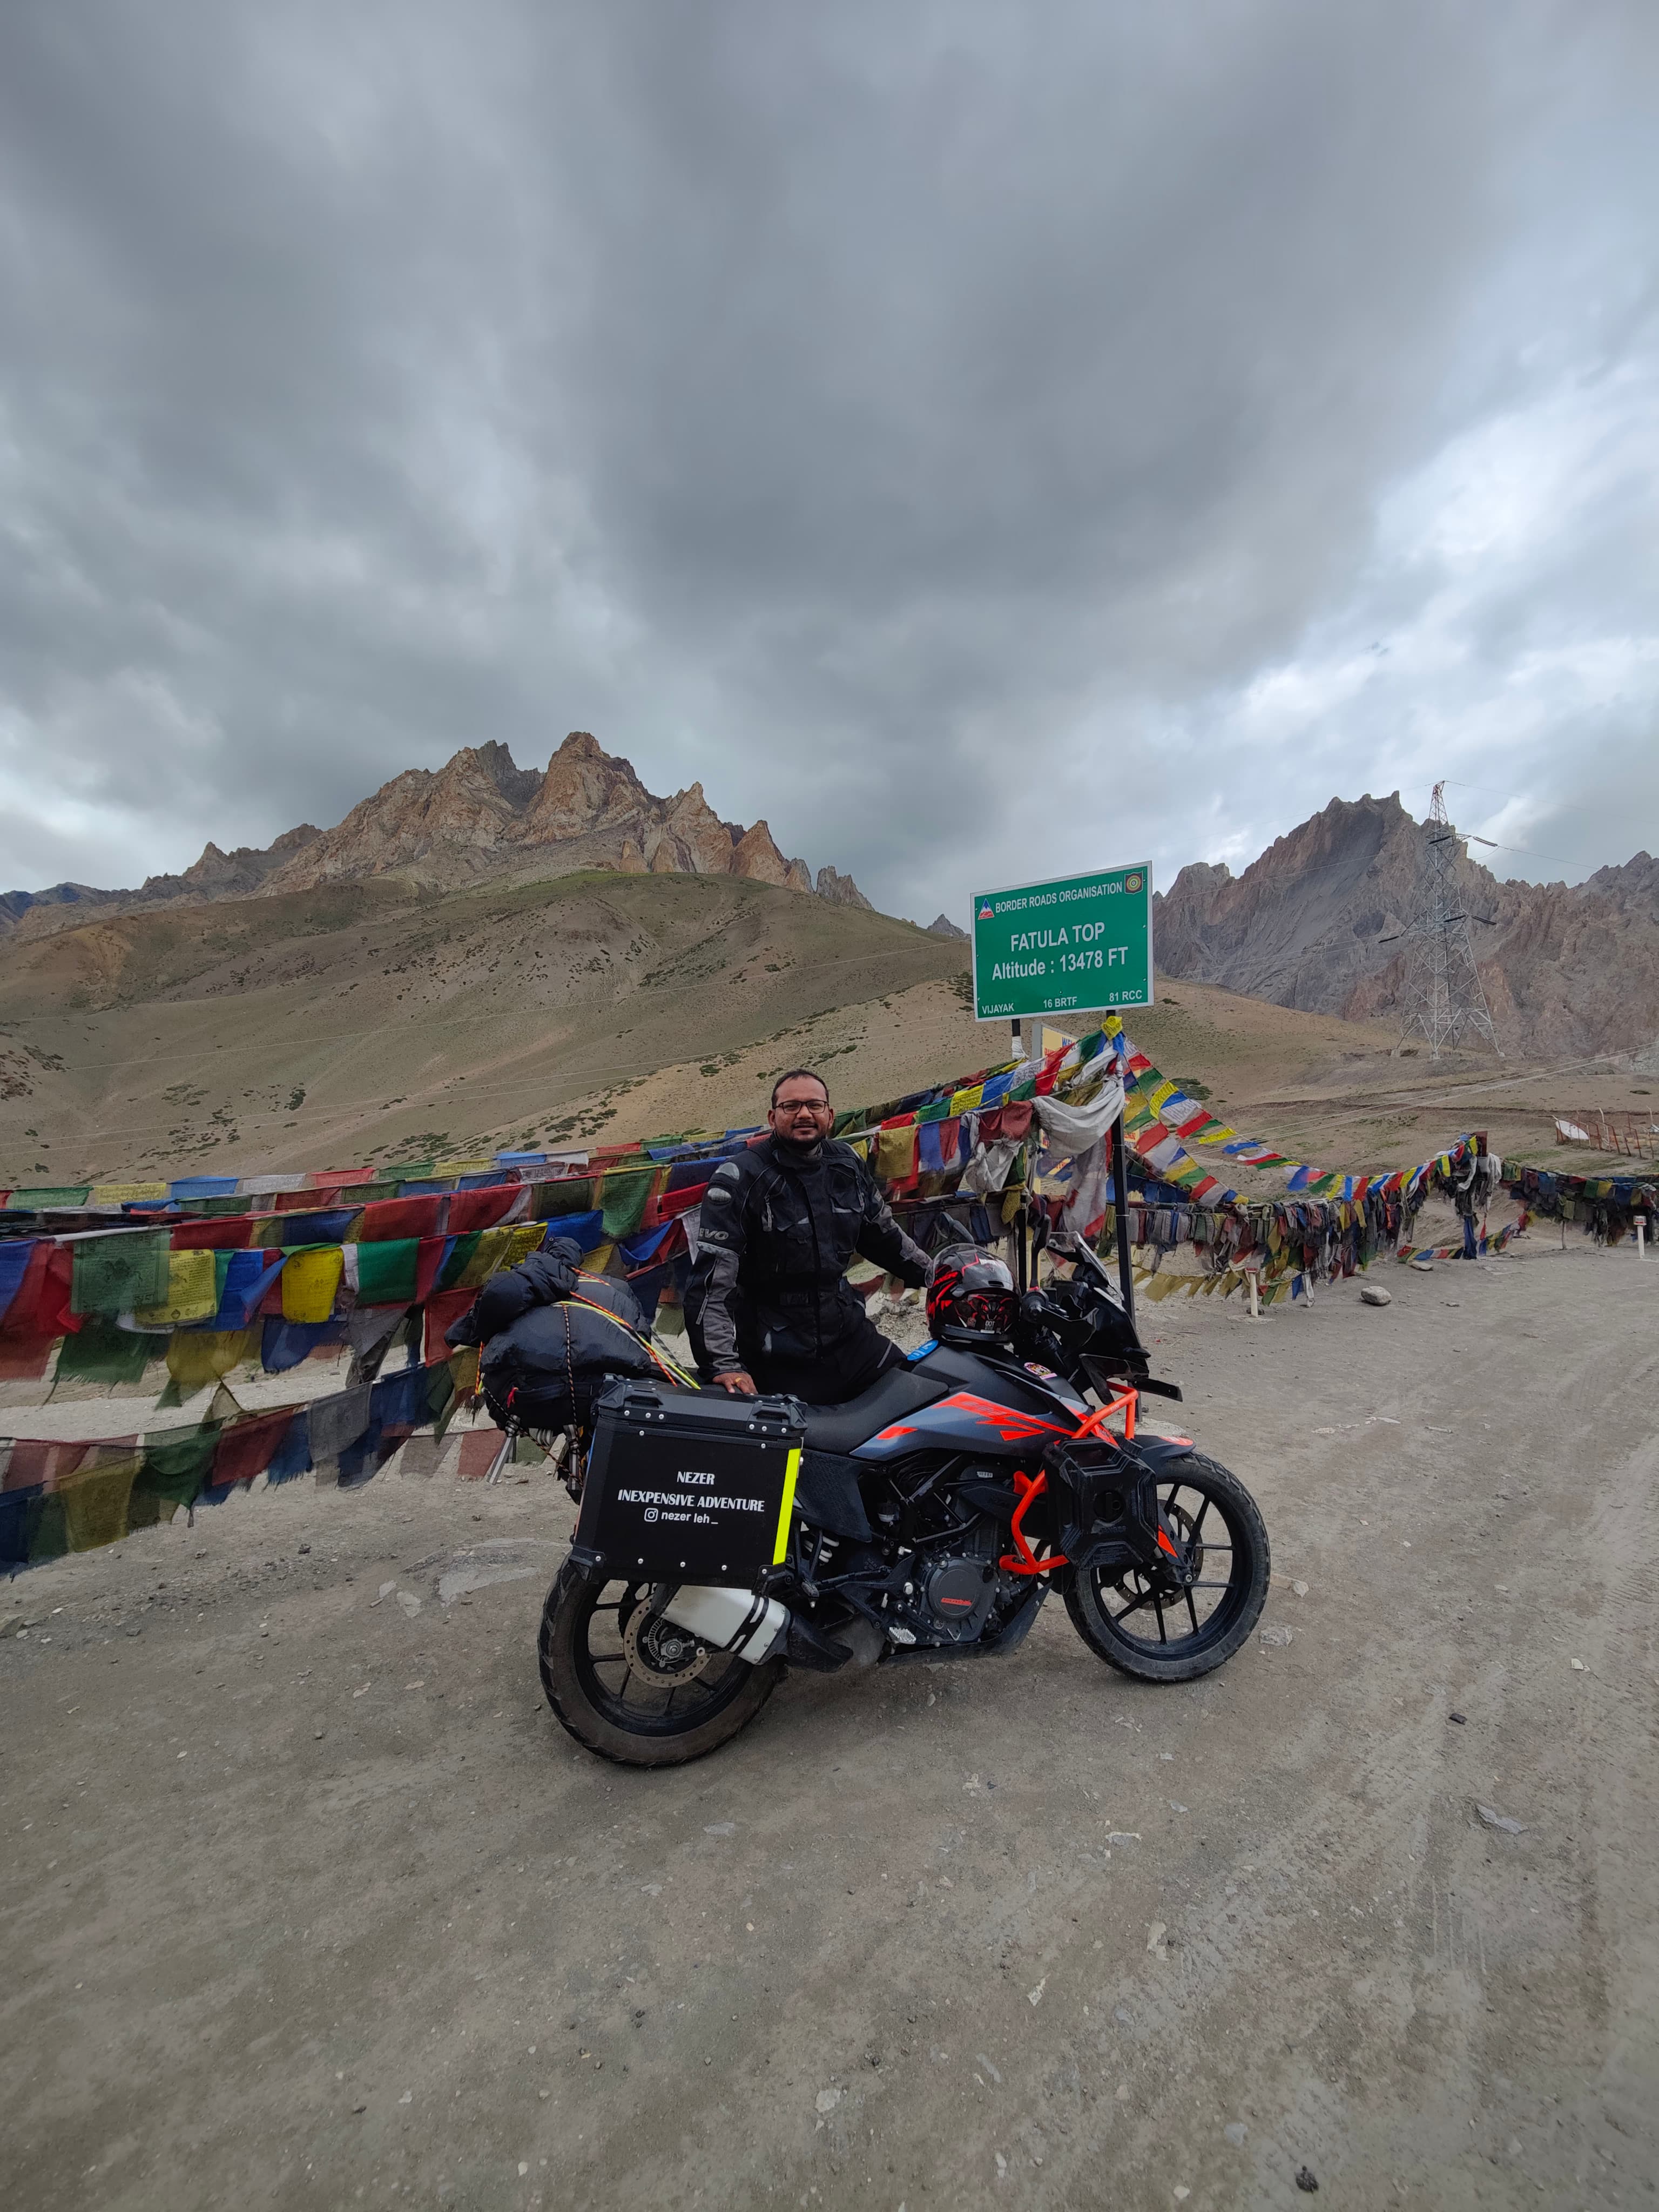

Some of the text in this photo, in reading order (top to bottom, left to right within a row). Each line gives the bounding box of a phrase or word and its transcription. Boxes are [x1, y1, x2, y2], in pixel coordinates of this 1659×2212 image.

[995, 881, 1122, 913] BORDER ROADS ORGANISATION
[1011, 922, 1105, 952] FATULA TOP
[992, 958, 1046, 980] Altitude
[1060, 950, 1103, 972] 13478
[1108, 946, 1128, 966] FT
[1043, 996, 1077, 1008] 16 BRTF
[1109, 989, 1142, 1002] 81 RCC
[982, 1003, 1014, 1014] VIJAYAK
[677, 1471, 715, 1485] NEZER
[618, 1489, 765, 1512] INEXPENSIVE ADVENTURE
[661, 1512, 692, 1521] nezer
